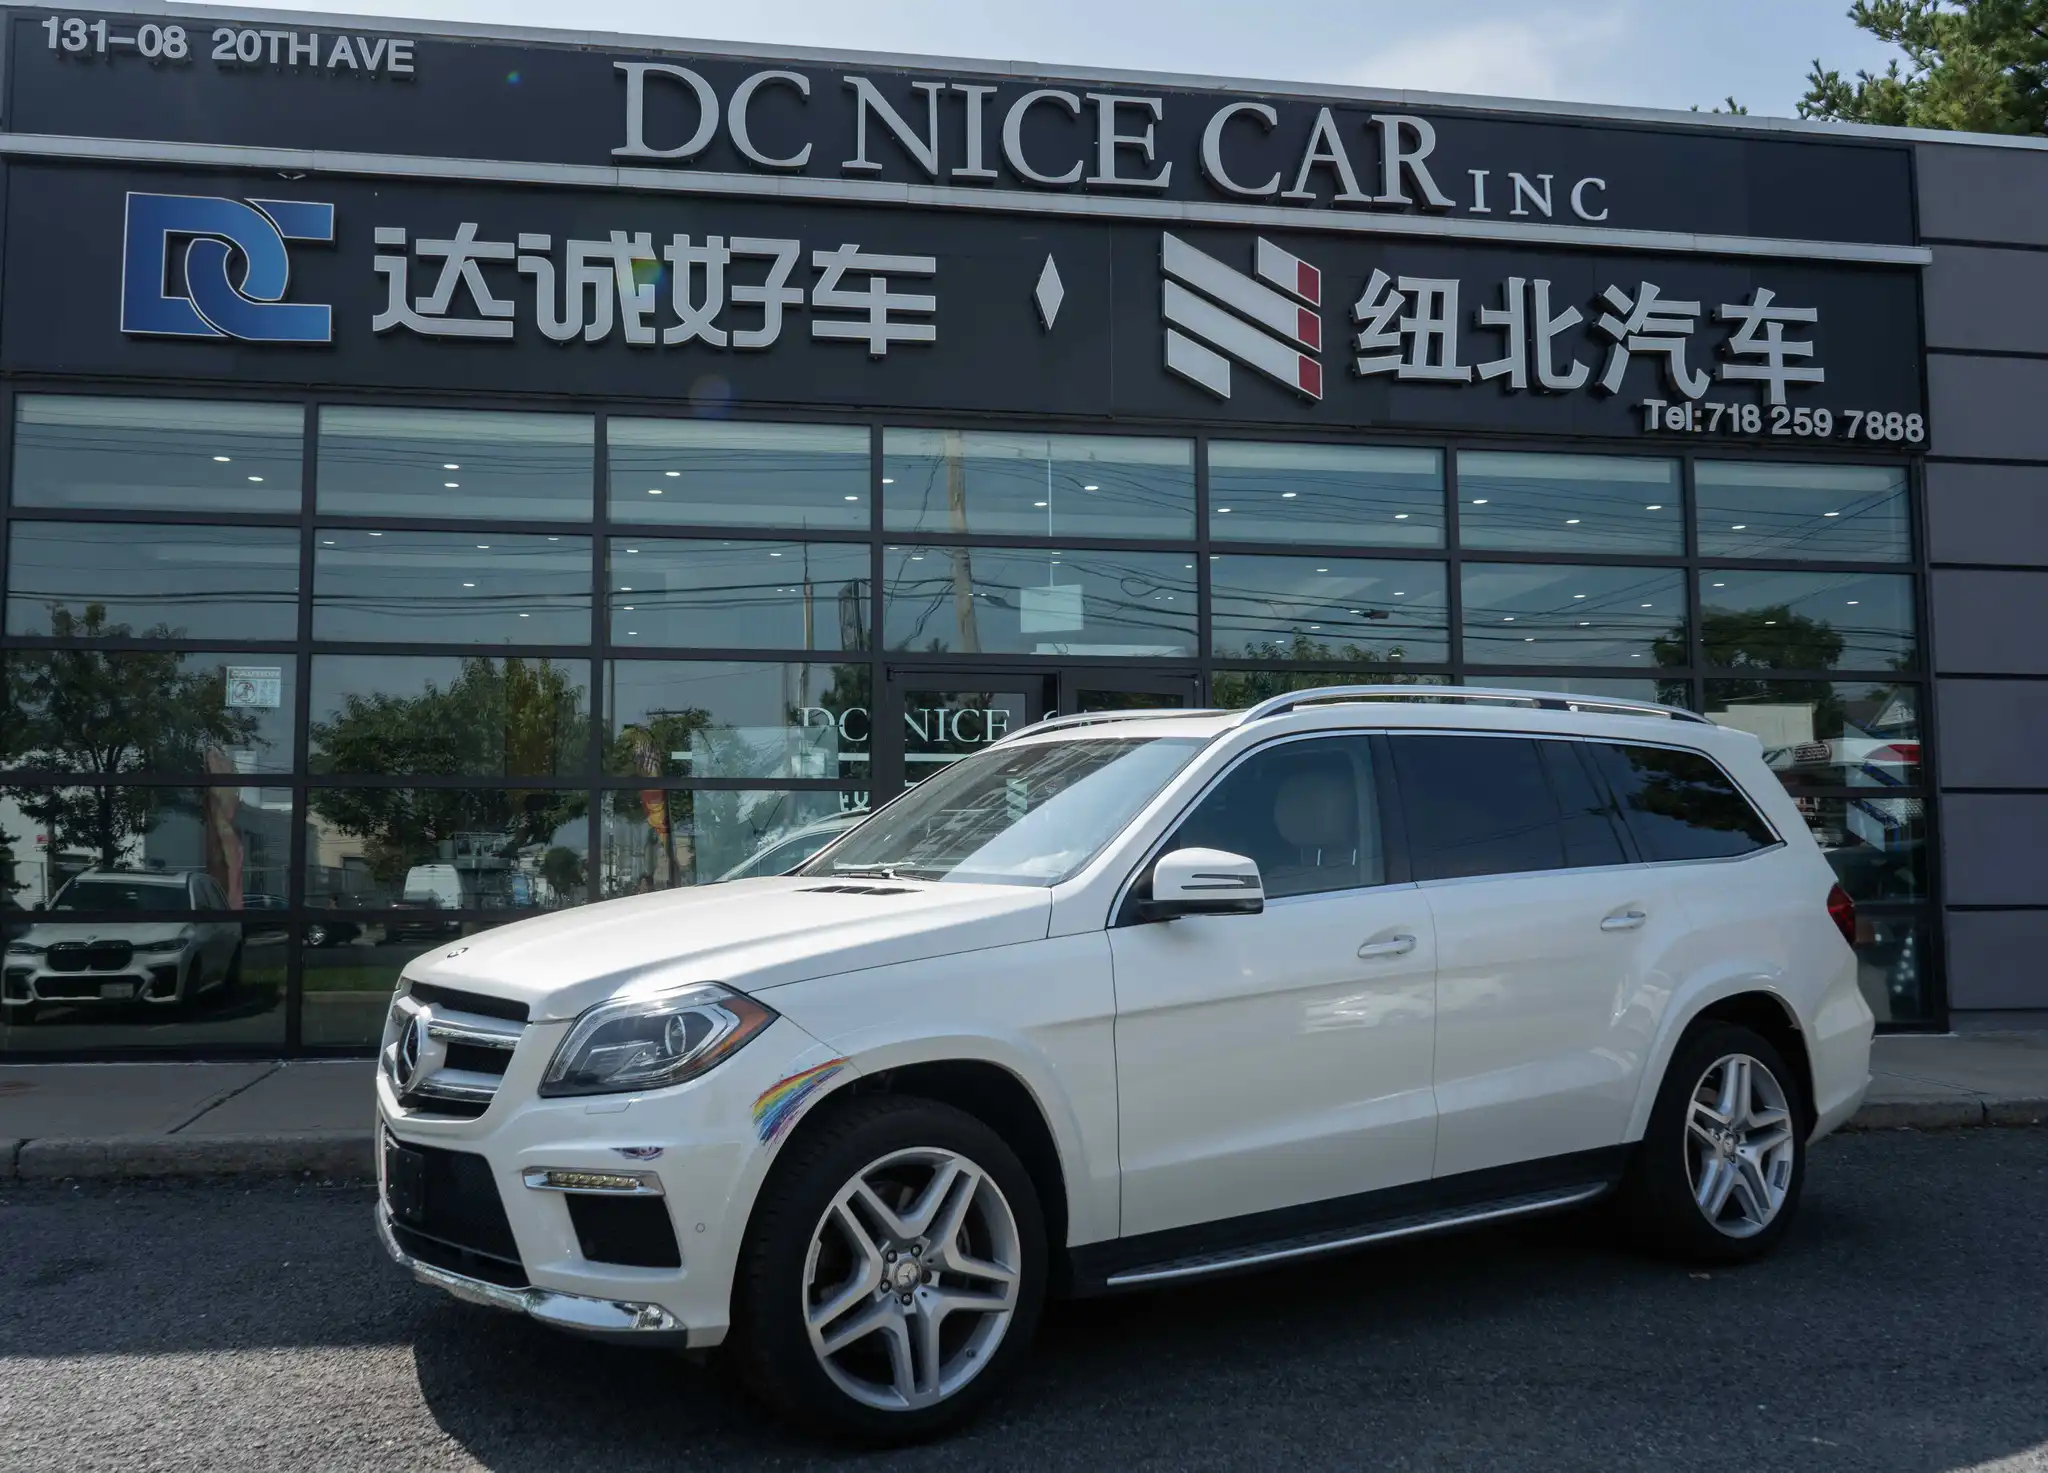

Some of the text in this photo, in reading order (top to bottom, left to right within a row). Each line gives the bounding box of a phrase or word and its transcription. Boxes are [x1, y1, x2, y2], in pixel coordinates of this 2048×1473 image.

[42, 16, 415, 73] 131-08 20TH AVE
[611, 61, 1609, 221] DC NICE CAR INC
[120, 191, 334, 342] DC
[373, 222, 936, 355] 达诚好车
[1354, 268, 1825, 405] 纽北汽车
[1771, 405, 1833, 437] 259
[1844, 409, 1924, 443] 7888
[904, 708, 1010, 742] NICE
